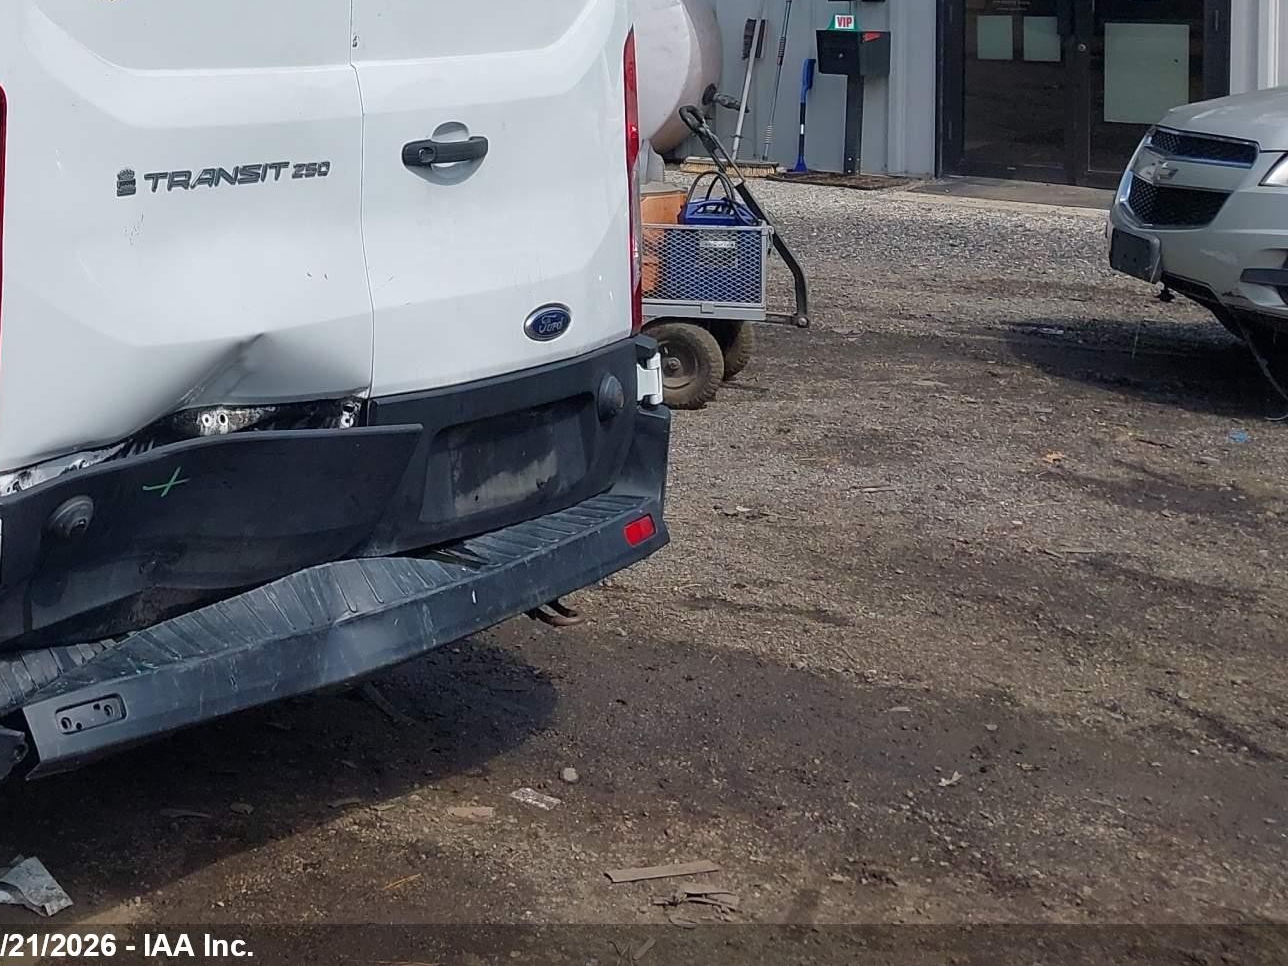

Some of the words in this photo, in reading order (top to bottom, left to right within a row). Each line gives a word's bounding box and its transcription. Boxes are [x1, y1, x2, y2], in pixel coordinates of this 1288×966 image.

[836, 16, 853, 28] VIP
[143, 161, 290, 193] TRANSIT
[291, 161, 330, 180] 250
